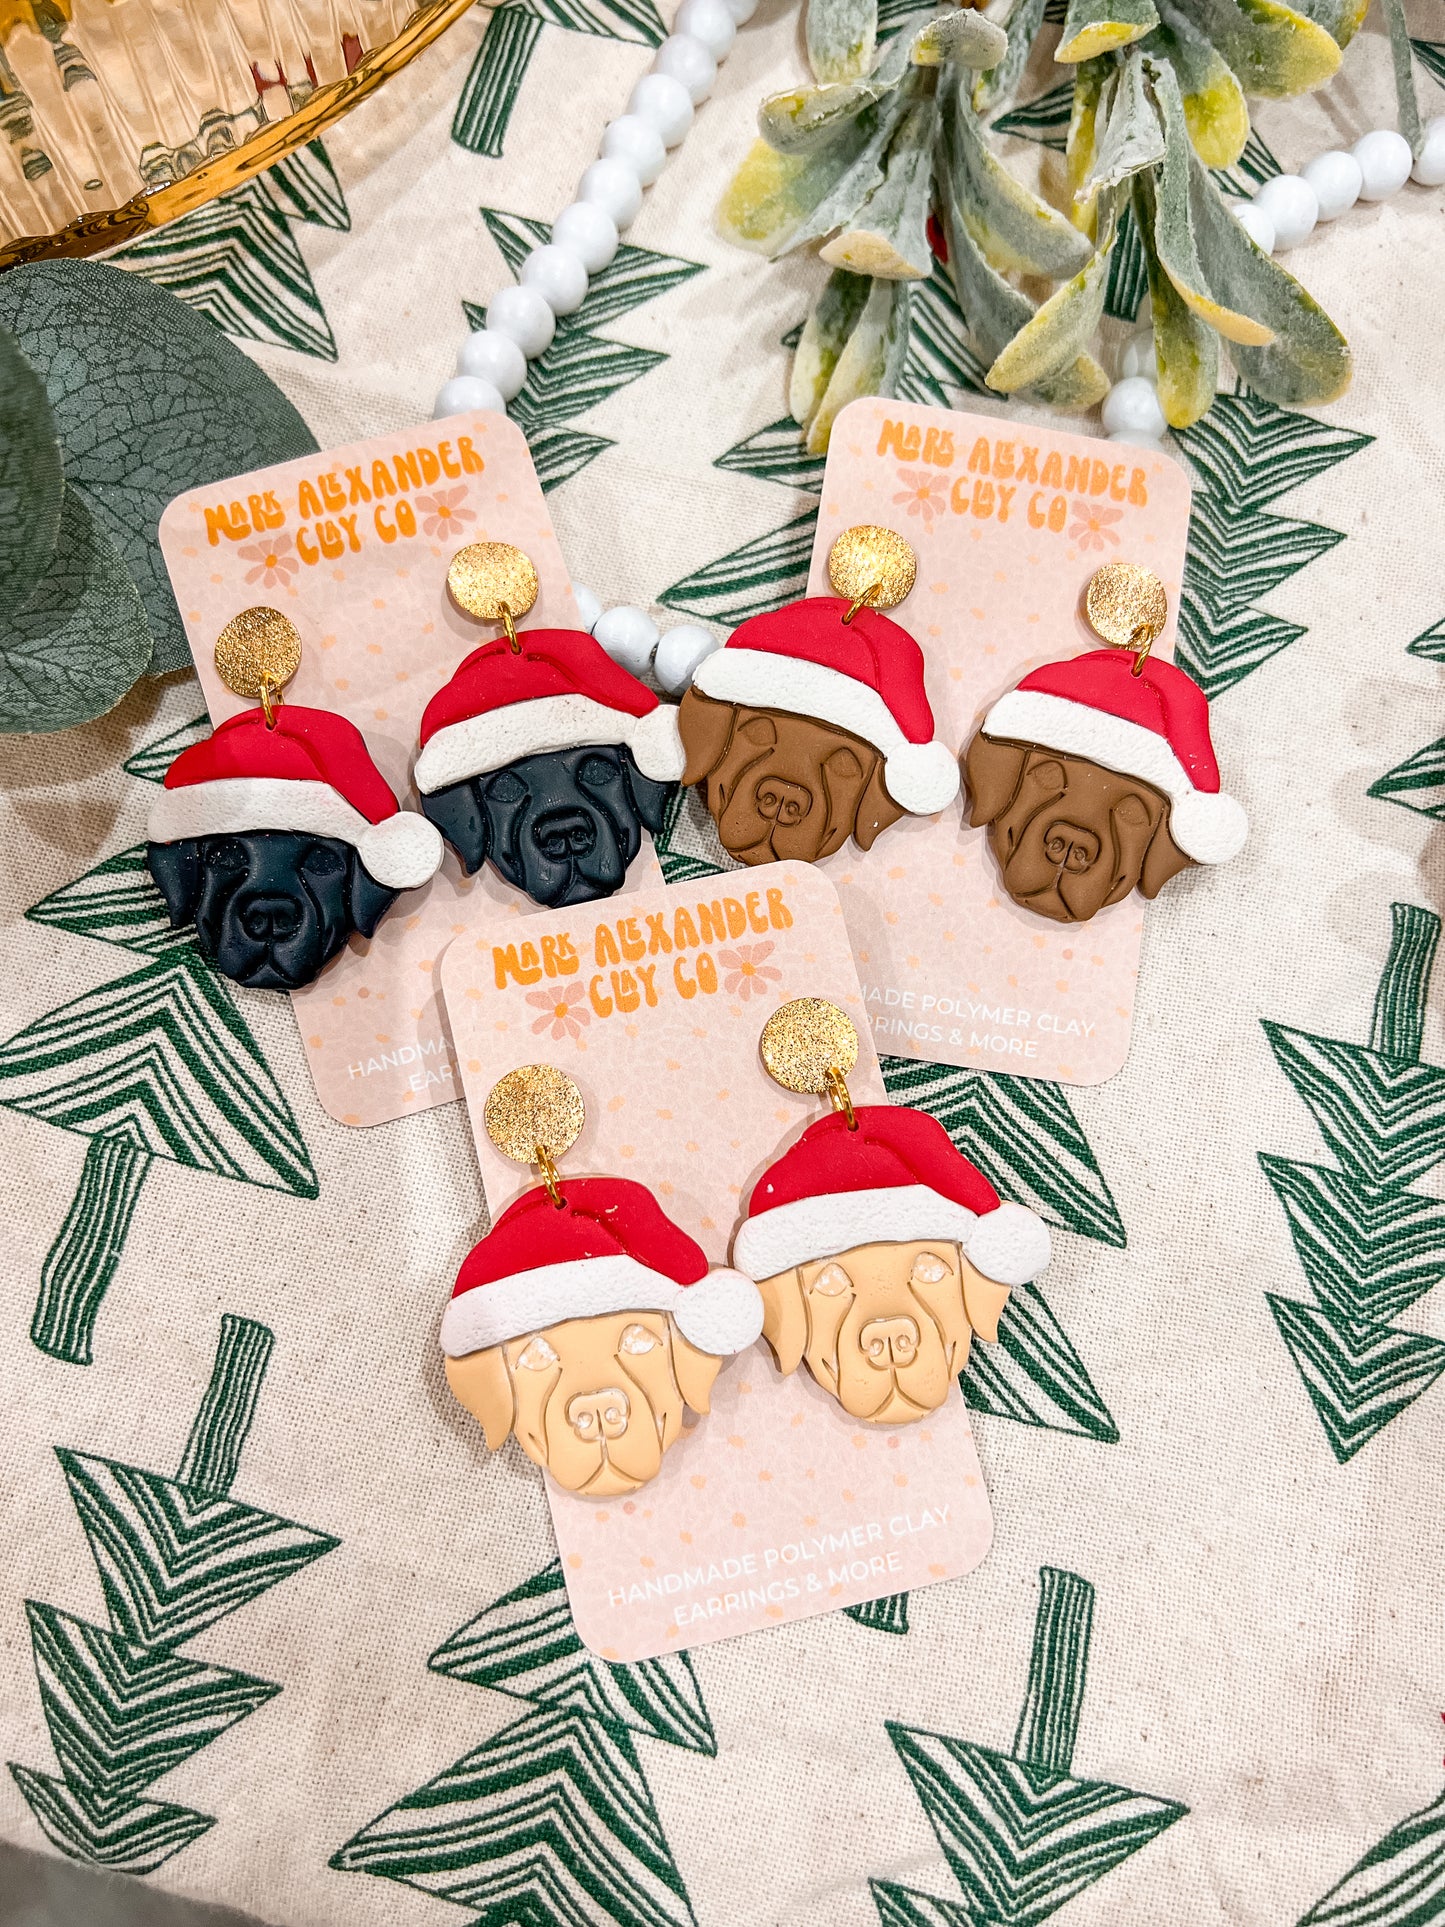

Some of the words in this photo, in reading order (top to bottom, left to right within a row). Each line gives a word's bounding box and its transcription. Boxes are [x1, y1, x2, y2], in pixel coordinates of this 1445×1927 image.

[203, 489, 286, 547] MARK
[298, 435, 485, 521] ALEXANDER
[876, 419, 955, 468] MARK
[967, 436, 1148, 508] ALEXANDER
[295, 512, 362, 566] CLAY
[373, 498, 418, 544] CO
[950, 476, 1016, 523] CLAY
[1027, 490, 1067, 534] CO
[492, 931, 580, 990] MARK
[594, 887, 794, 968] ALEXANDER
[588, 963, 659, 1019] CLAY
[673, 951, 718, 1000] CO
[921, 995, 1031, 1028] POLYMER
[1037, 1013, 1096, 1038] CLAY
[949, 1028, 963, 1046] &
[970, 1031, 1039, 1058] MORE
[607, 1553, 757, 1608] HANDMADE
[763, 1522, 884, 1570] POLYMER
[889, 1504, 951, 1538] CLAY
[673, 1580, 801, 1627] EARRINGS
[806, 1572, 822, 1593] &
[828, 1550, 903, 1588] MORE
